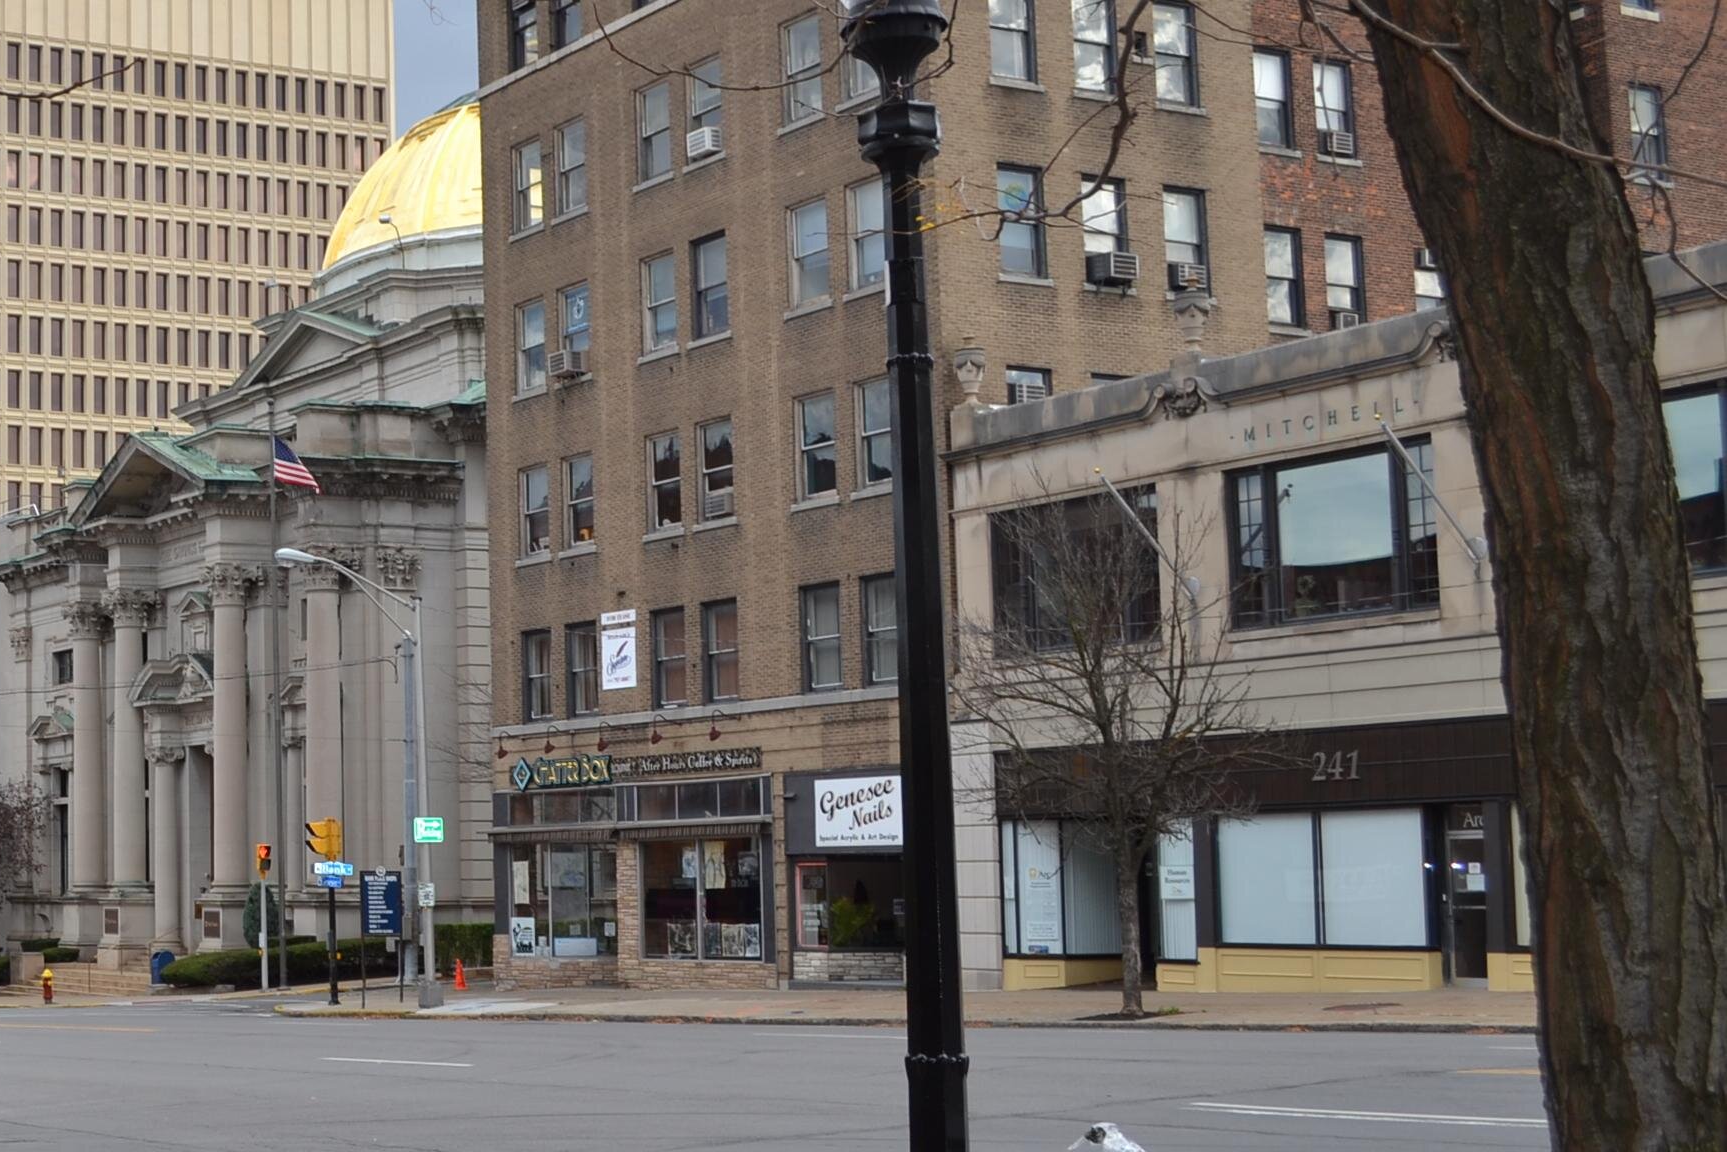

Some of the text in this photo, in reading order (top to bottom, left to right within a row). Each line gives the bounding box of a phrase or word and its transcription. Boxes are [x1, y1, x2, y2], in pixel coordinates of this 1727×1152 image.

[1242, 398, 1404, 443] MITCHELL
[687, 754, 712, 769] Coffee
[714, 752, 723, 767] &
[1311, 749, 1361, 781] 241
[819, 779, 894, 822] Genesee
[848, 799, 892, 830] Nails
[840, 833, 859, 842] Acrylic
[868, 833, 877, 841] Art
[879, 832, 899, 842] Design
